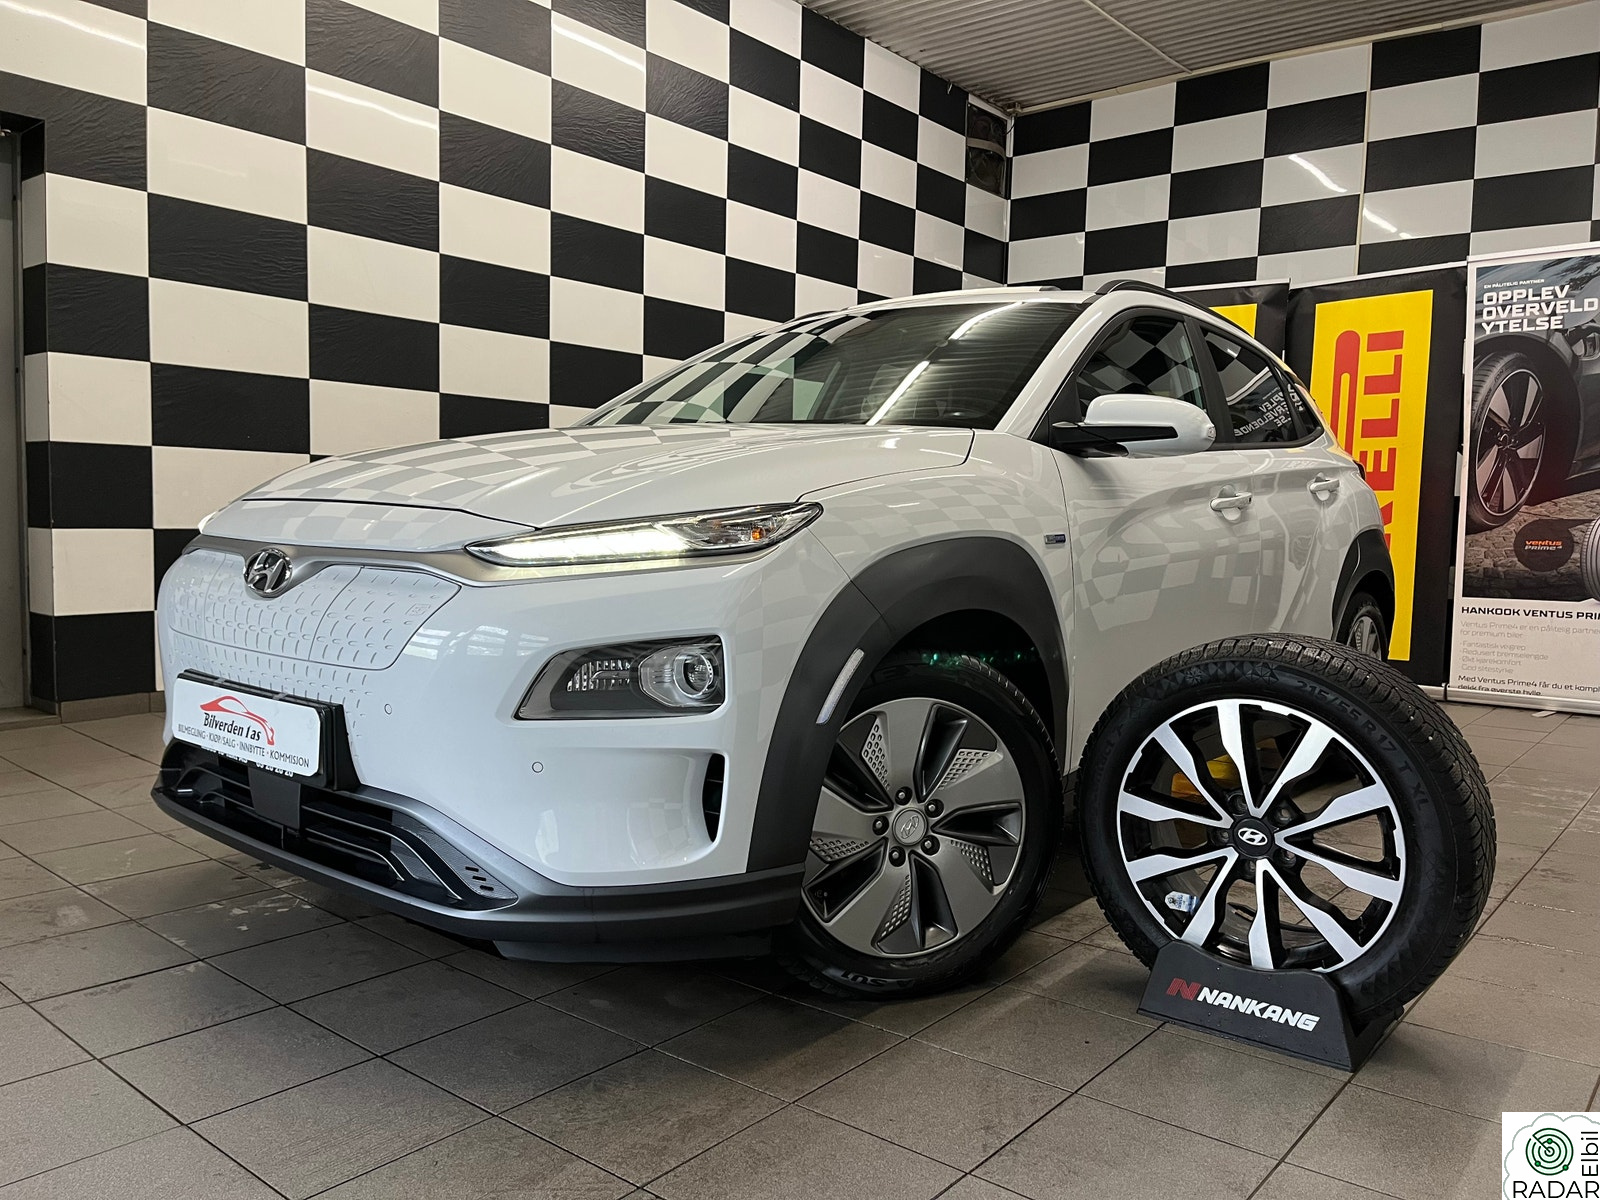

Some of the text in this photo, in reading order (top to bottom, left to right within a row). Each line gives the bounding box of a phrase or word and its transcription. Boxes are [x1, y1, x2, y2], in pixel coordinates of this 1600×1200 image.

[1483, 285, 1570, 306] OPPLEV
[1482, 316, 1563, 334] YTELSE
[1461, 606, 1600, 620] HANKOOK VENTUS PRI
[1460, 621, 1488, 629] Ventus
[1477, 676, 1506, 685] Ventus
[1507, 678, 1537, 687] Prime4
[1552, 682, 1562, 690] du
[203, 712, 244, 737] Bilverden
[250, 729, 262, 741] as
[239, 741, 265, 757] INNBYTTE
[269, 749, 310, 768] KOMMISJON
[1197, 987, 1320, 1032] NANKANG
